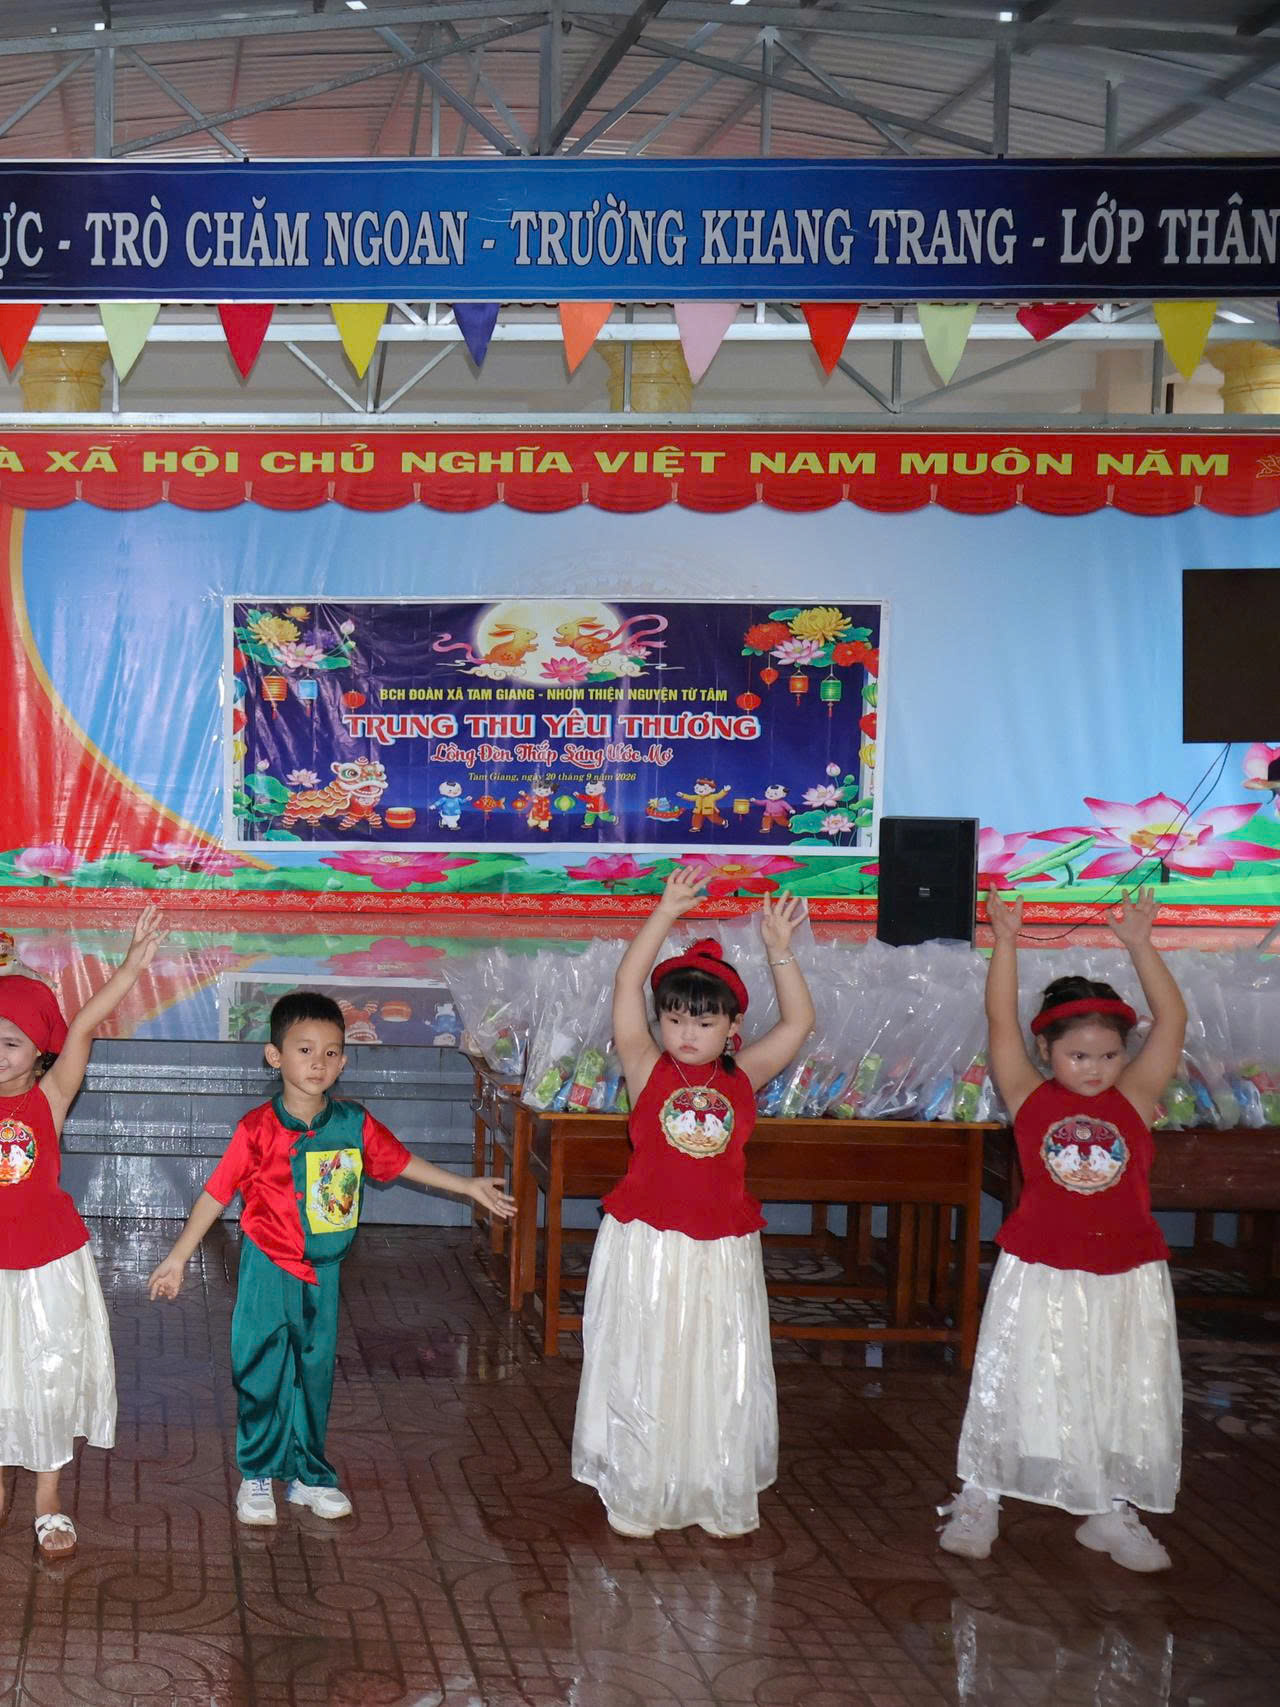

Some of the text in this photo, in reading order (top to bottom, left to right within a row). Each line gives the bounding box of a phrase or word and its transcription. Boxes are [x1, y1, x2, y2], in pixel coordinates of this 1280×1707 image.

[58, 240, 71, 250] -
[85, 195, 168, 267] TRÒ
[185, 196, 310, 267] CHĂM
[324, 210, 468, 266] NGOAN
[482, 239, 495, 249] -
[510, 192, 687, 266] TRƯỜNG
[700, 208, 854, 265] KHANG
[869, 208, 1017, 265] TRANG
[1032, 237, 1045, 247] -
[1060, 192, 1144, 264] LỚP
[1158, 191, 1280, 264] THÂN
[45, 445, 118, 473] XÃ
[143, 446, 239, 478] HỘI
[260, 443, 375, 474] CHỦ
[401, 446, 574, 474] NGHĨA
[594, 446, 726, 478] VIỆT
[750, 452, 876, 475] NAM
[900, 448, 1073, 475] MUÔN
[1097, 449, 1229, 476] NĂM
[379, 688, 406, 701] BCH
[408, 686, 444, 701] ĐOÀN
[446, 686, 464, 701] XÃ
[467, 688, 493, 701] TAM
[495, 688, 535, 701] GIANG
[547, 686, 585, 701] NHÓM
[588, 686, 625, 703] THIỆN
[628, 686, 678, 703] NGUYỆN
[700, 687, 728, 702] TÂM
[343, 708, 761, 745] TRUNG THU YÊU THƯƠNG
[431, 742, 477, 768] Lồng
[478, 743, 514, 763] Đèn
[514, 740, 558, 767] Thắp
[560, 743, 605, 770] Sáng
[642, 744, 674, 767] Mơ
[468, 772, 488, 781] Tam
